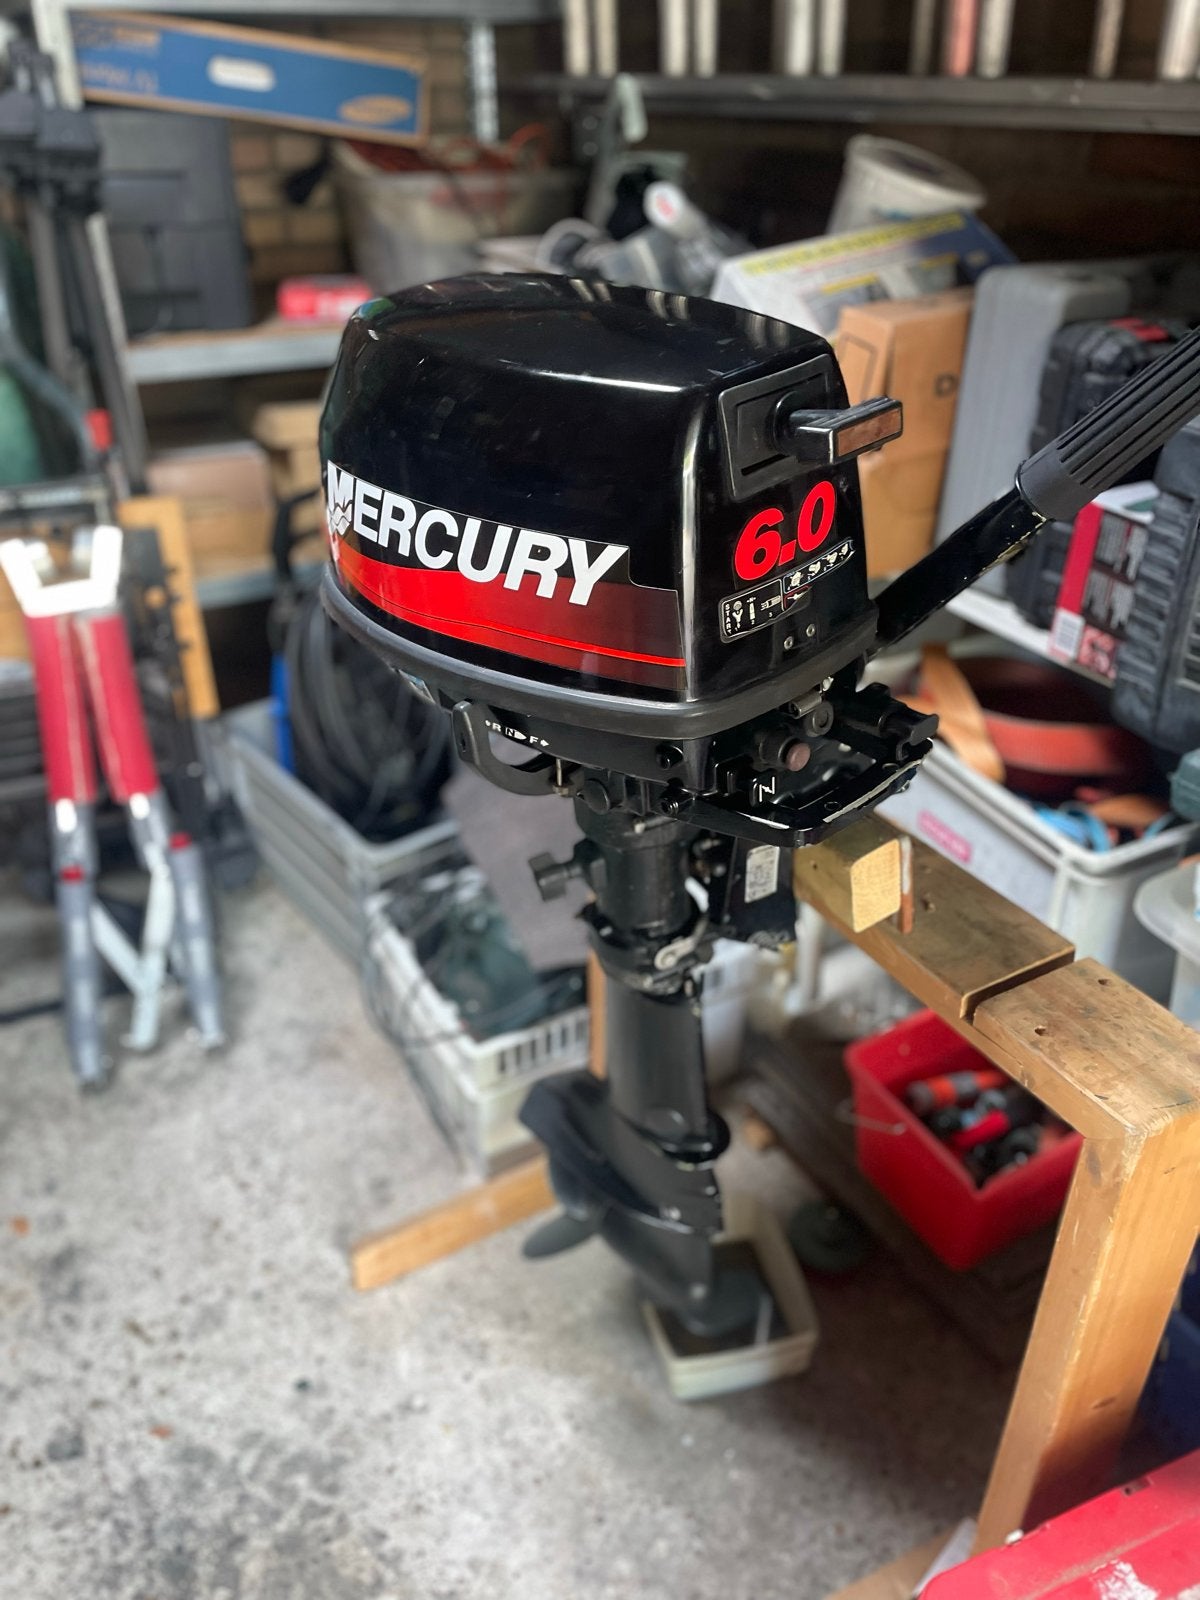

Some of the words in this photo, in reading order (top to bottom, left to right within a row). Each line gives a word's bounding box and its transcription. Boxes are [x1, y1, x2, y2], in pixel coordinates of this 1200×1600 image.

[326, 459, 628, 607] MERCURY
[735, 481, 836, 581] 6.0
[492, 722, 502, 732] R
[529, 735, 539, 744] F
